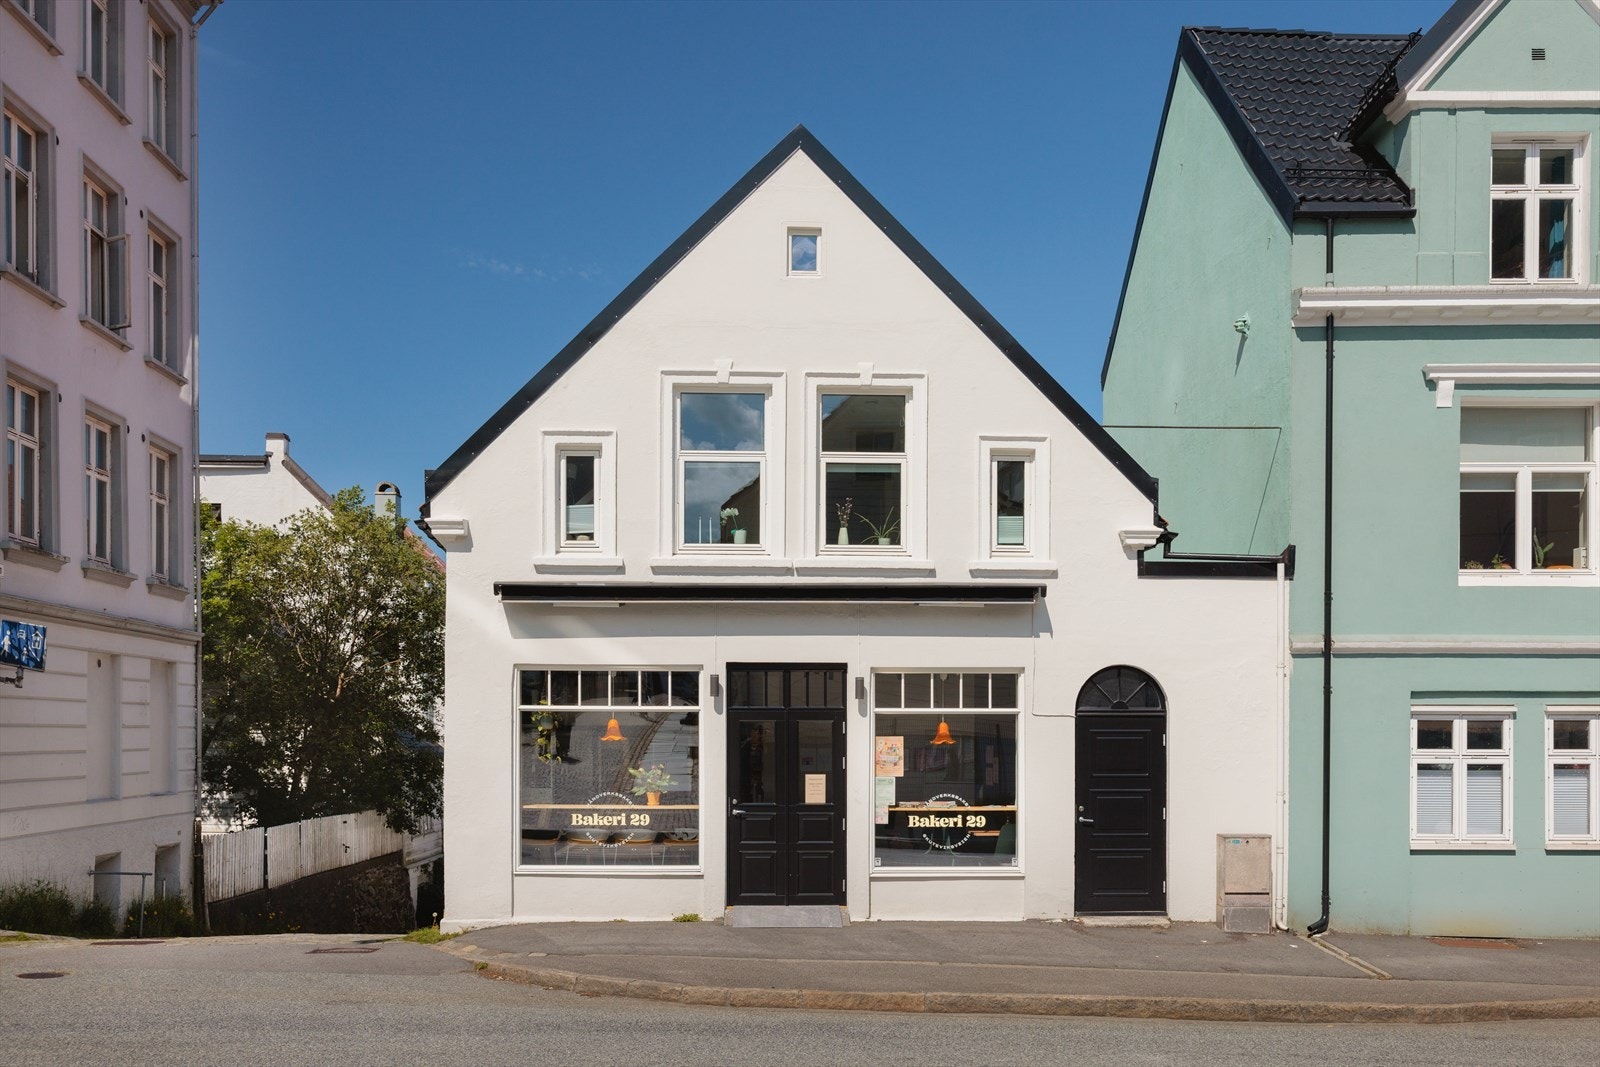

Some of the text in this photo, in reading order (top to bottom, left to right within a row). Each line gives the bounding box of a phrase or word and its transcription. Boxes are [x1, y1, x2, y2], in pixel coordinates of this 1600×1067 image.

[571, 813, 650, 826] Bakeri 29
[907, 814, 986, 828] Bakeri 29
[922, 833, 971, 850] SKUTEVIKSVEIEN
